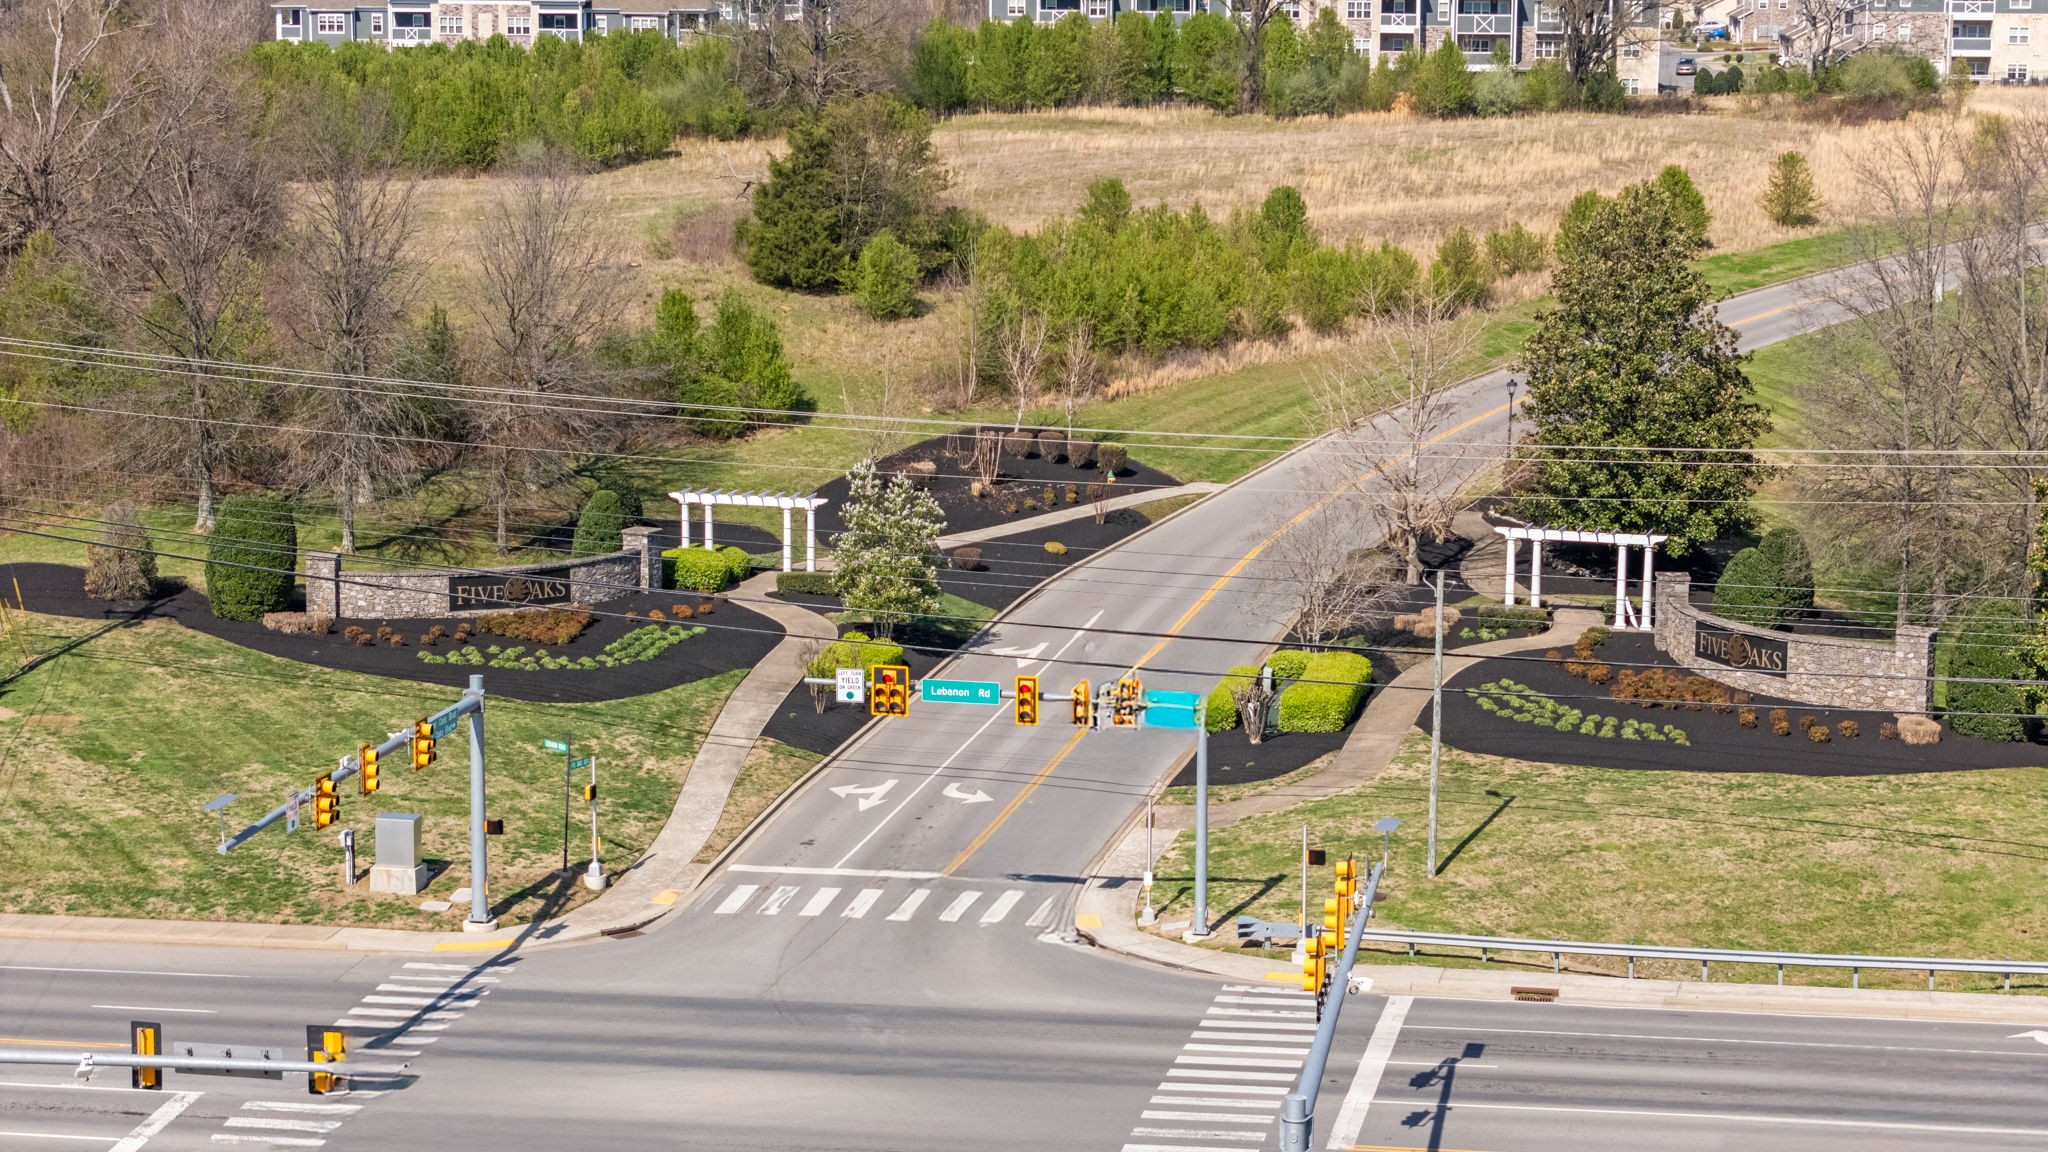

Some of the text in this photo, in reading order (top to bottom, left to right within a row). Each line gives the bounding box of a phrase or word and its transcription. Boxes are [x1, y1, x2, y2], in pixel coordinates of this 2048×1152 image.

[456, 585, 505, 605] FIVE
[1699, 632, 1729, 659] FIVE
[931, 685, 991, 698] Lebanon Rd
